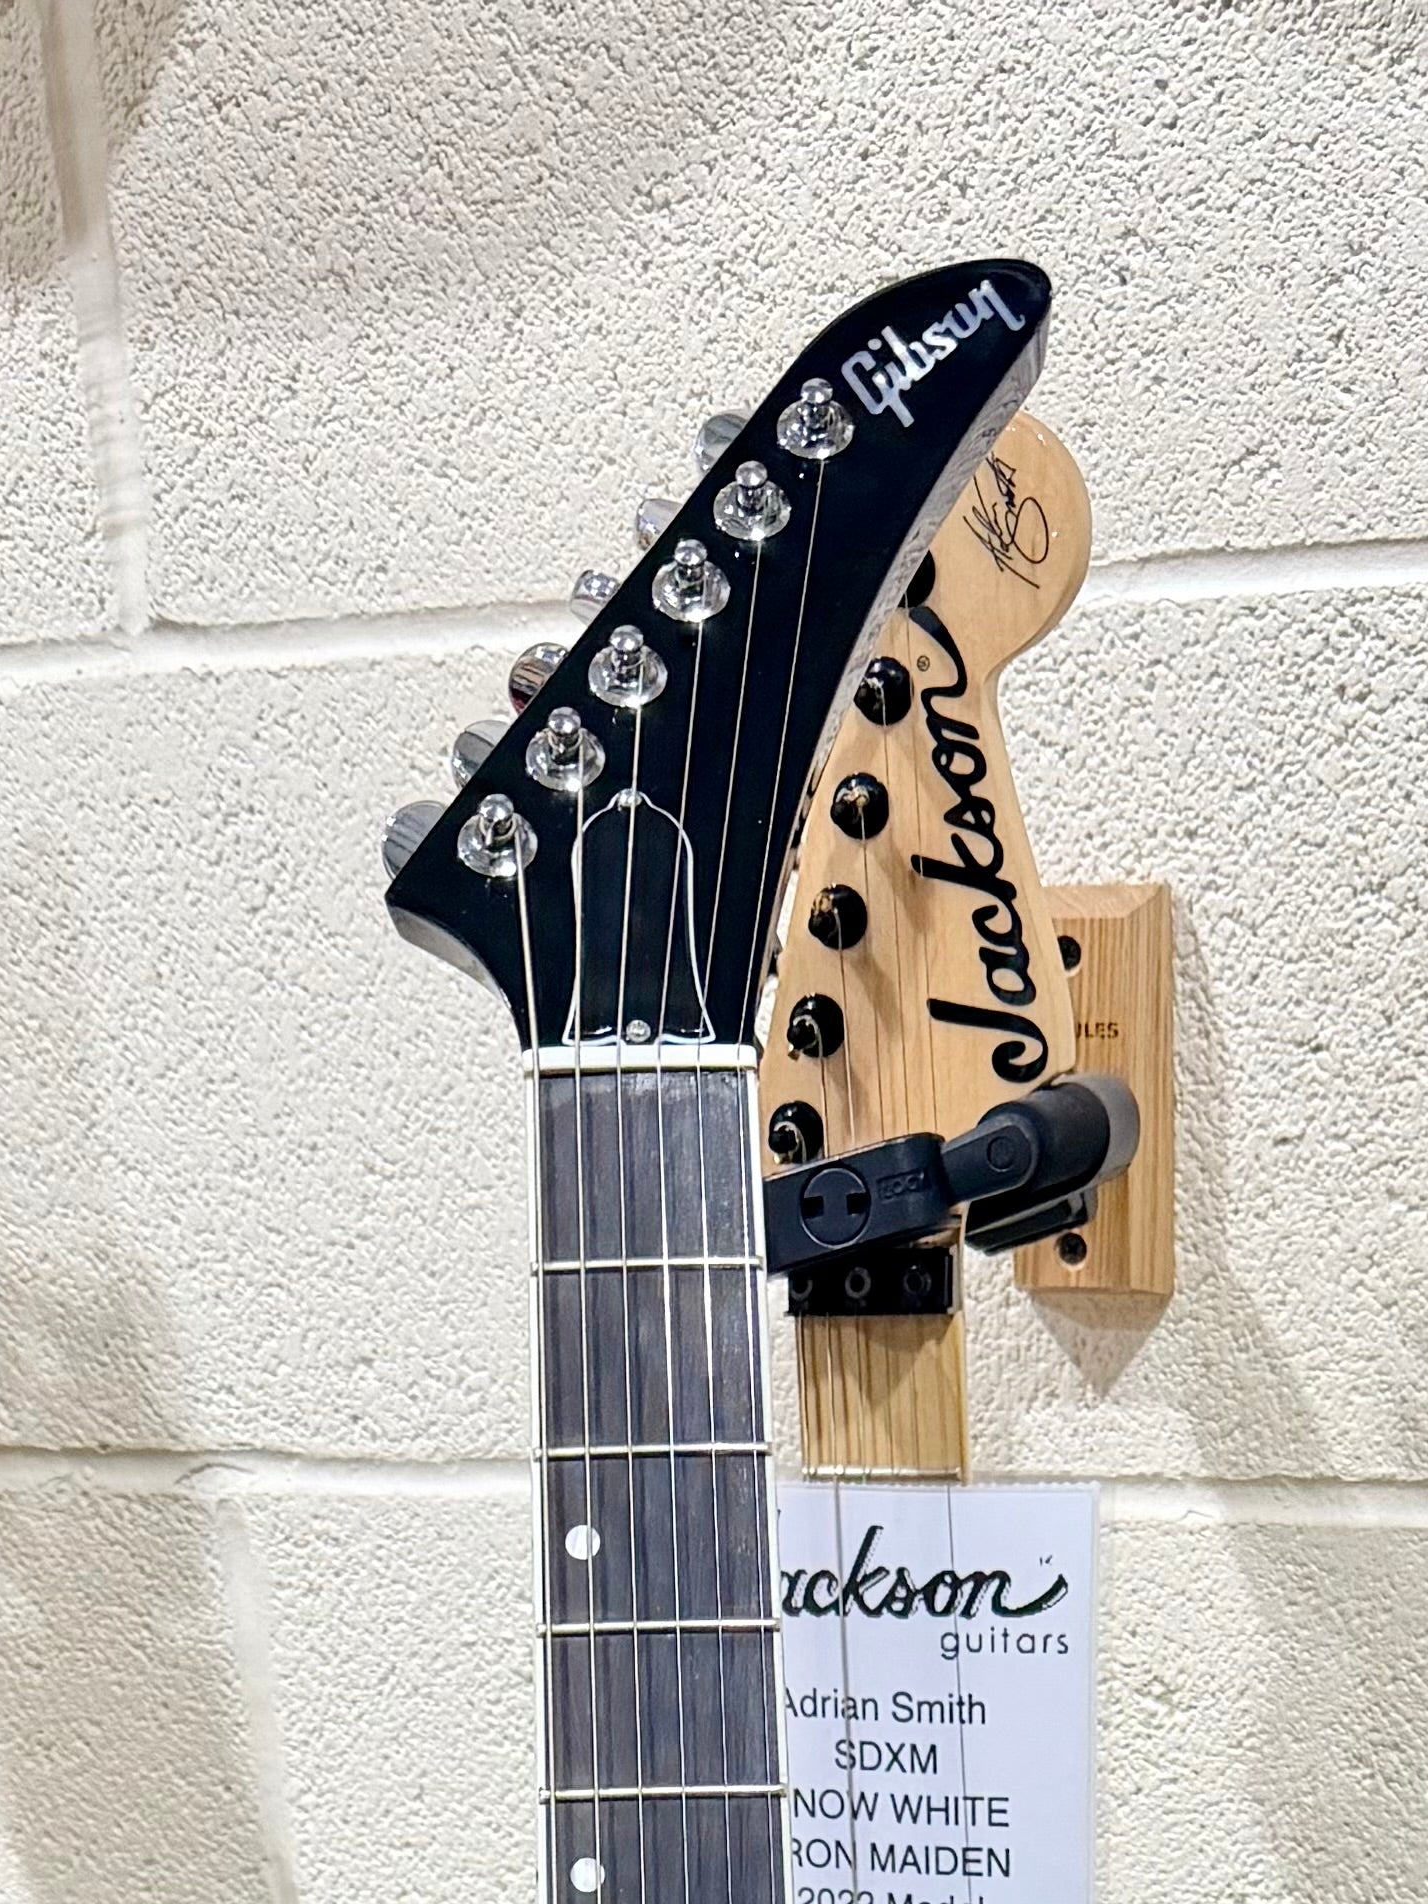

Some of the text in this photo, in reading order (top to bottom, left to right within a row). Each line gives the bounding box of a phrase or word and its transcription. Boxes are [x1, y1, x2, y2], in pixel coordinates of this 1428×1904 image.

[841, 279, 1025, 427] Gibson
[909, 606, 1048, 1084] Jackson
[781, 1525, 1068, 1619] ackson
[941, 1627, 1069, 1660] guitars
[891, 1691, 985, 1724] Smith
[834, 1740, 938, 1775] SDXM
[793, 1788, 1009, 1827] NOW WHITE
[792, 1838, 1010, 1877] RON MAIDEN
